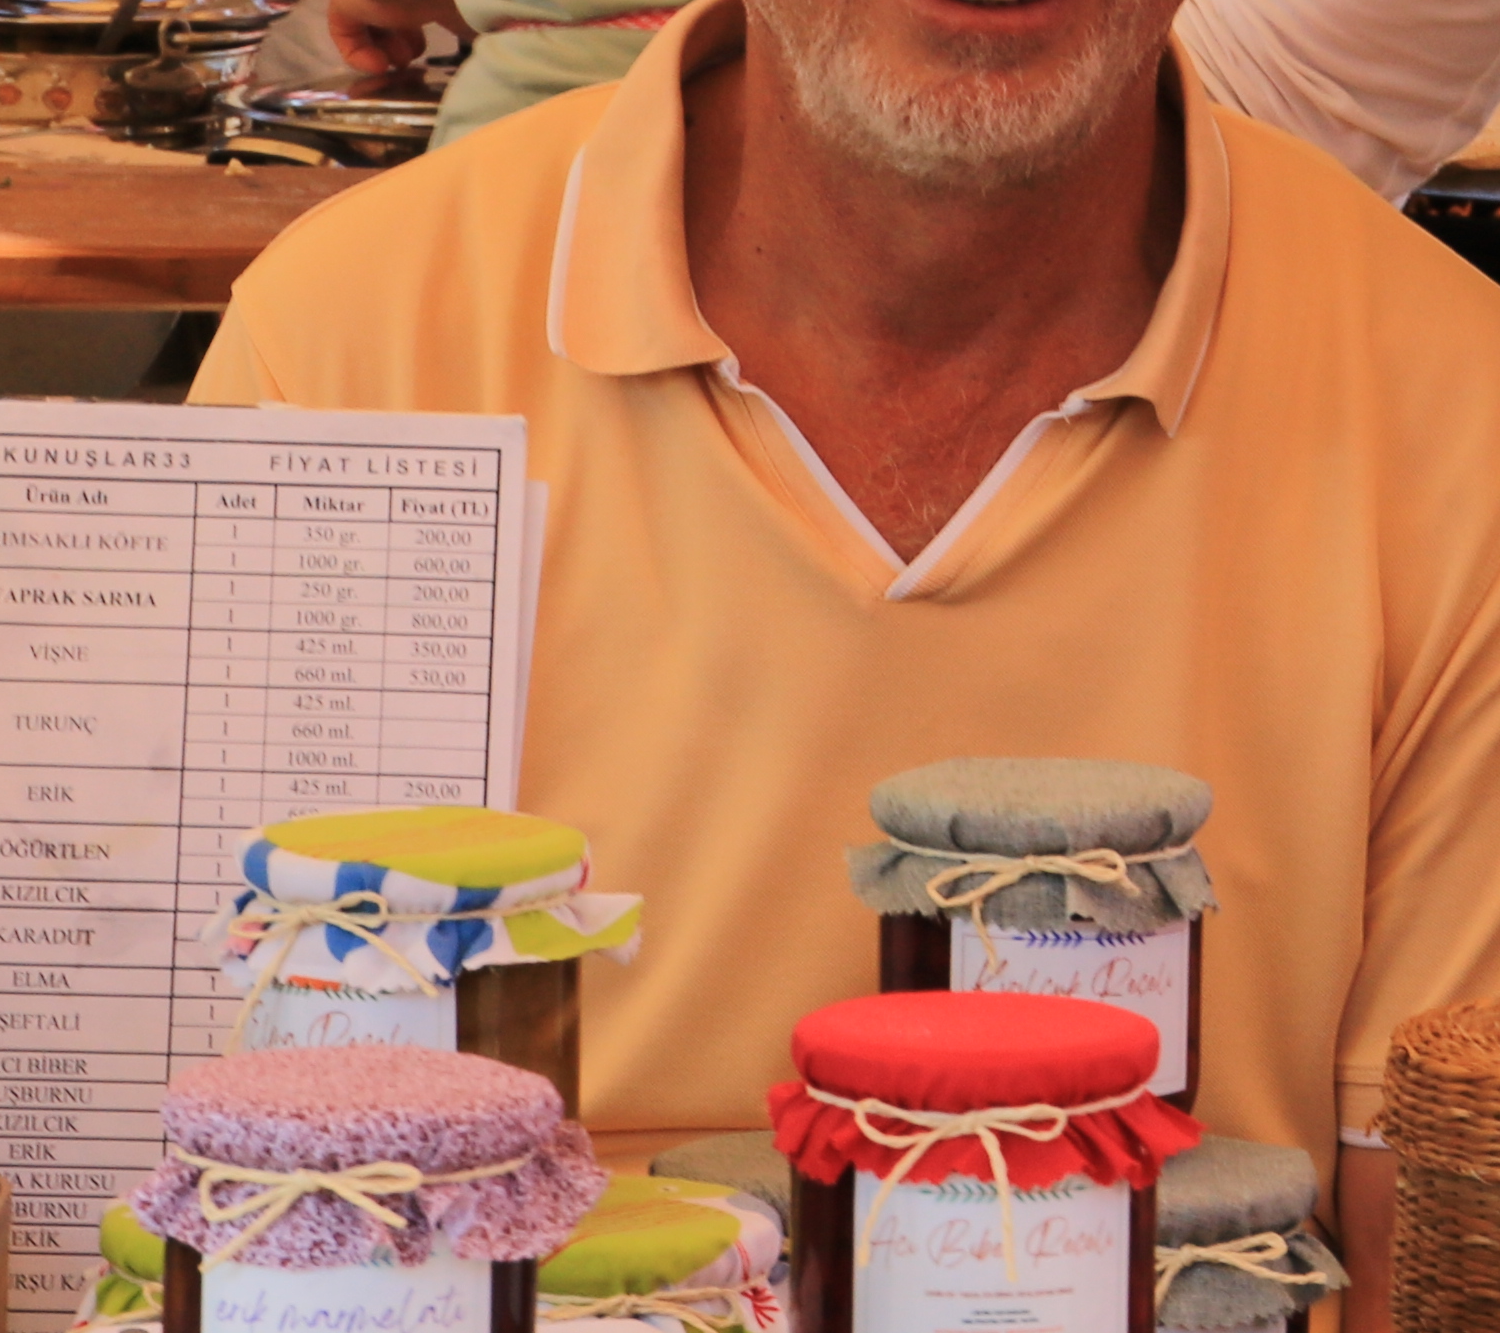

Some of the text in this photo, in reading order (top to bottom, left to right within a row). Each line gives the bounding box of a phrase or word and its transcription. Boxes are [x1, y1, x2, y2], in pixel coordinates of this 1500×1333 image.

[269, 453, 478, 477] FİYAT LİSTESİ
[26, 484, 72, 505] Ürün
[216, 493, 258, 511] Adet
[303, 495, 365, 514] Miktar
[400, 499, 446, 519] Fiyat
[98, 531, 170, 552] KÖFTE
[82, 589, 157, 608] SARMA
[28, 644, 90, 663] VİŞNE
[13, 714, 98, 735] TURUNÇ
[26, 783, 75, 803] ERİK
[0, 885, 90, 904] KIZILCIK
[11, 970, 71, 990] ELMA
[28, 1054, 89, 1076] BİBER
[8, 1141, 57, 1162] ERİK
[29, 1171, 117, 1192] KURUSU
[14, 1201, 89, 1221] BURNU
